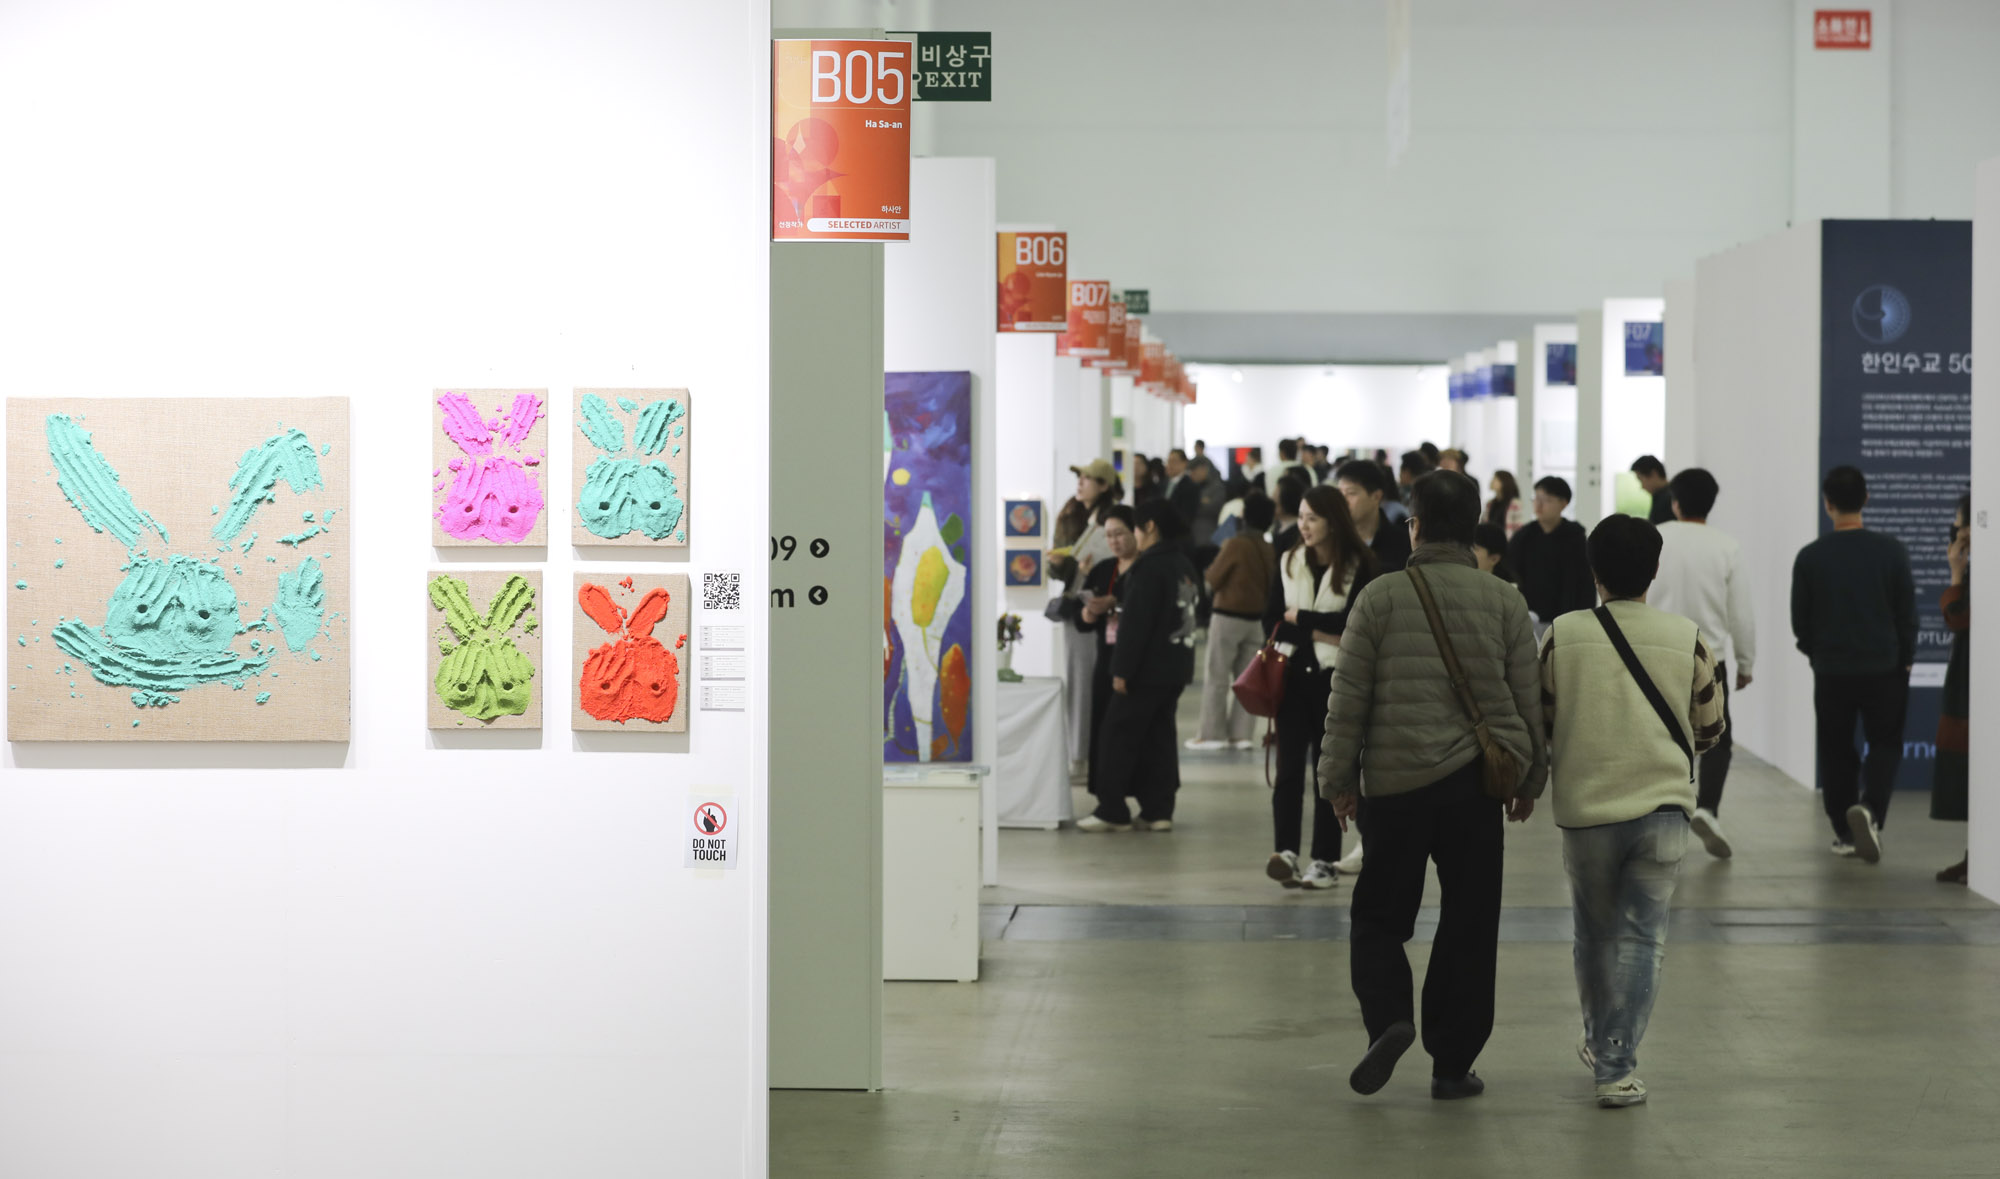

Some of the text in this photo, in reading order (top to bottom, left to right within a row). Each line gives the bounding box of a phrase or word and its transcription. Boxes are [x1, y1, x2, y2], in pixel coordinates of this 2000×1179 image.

[921, 45, 991, 68] 비상구
[812, 50, 905, 105] B05
[924, 71, 982, 88] EXIT
[865, 120, 903, 129] Ha Sa-an
[881, 205, 902, 214] 하사안
[827, 221, 902, 230] SELECTED ARTIST
[1016, 236, 1064, 265] B06
[1071, 283, 1108, 306] B07
[1861, 352, 1942, 374] 한인수교
[692, 838, 726, 849] DO NOT
[693, 849, 726, 861] TOUCH
